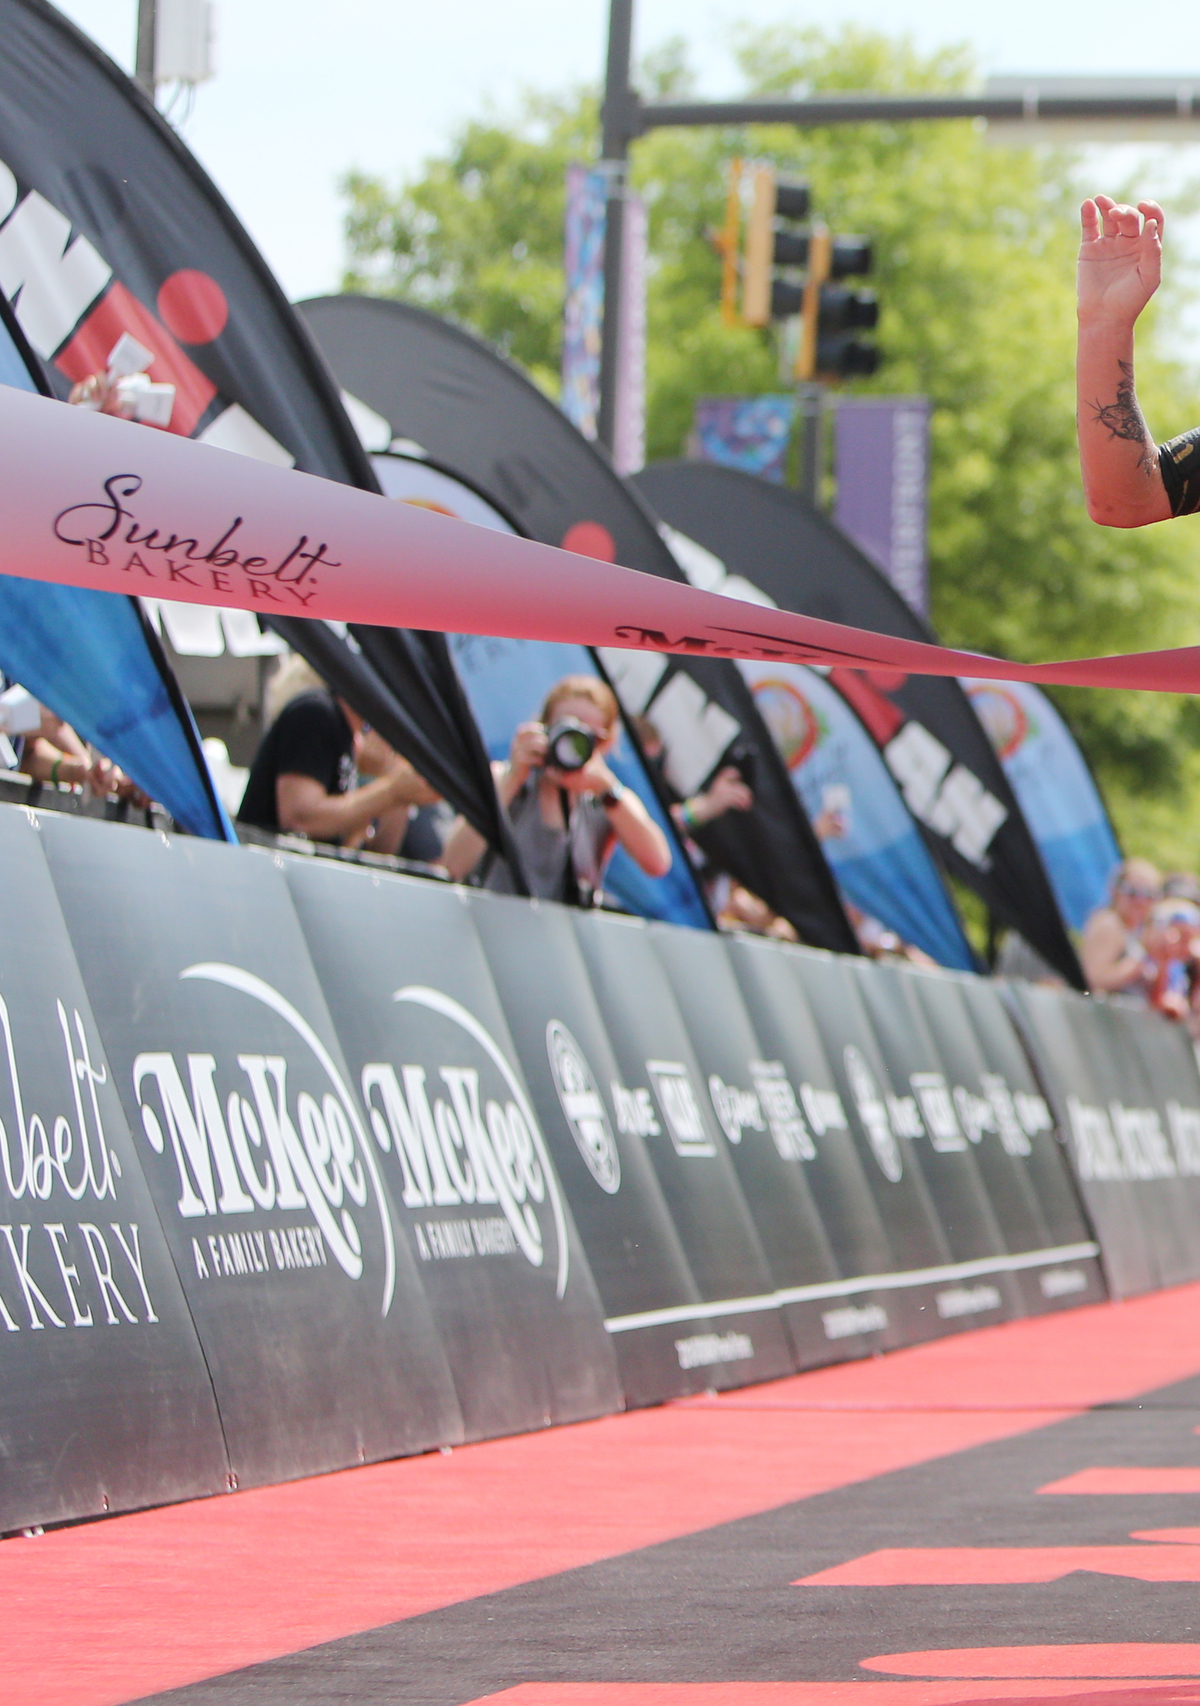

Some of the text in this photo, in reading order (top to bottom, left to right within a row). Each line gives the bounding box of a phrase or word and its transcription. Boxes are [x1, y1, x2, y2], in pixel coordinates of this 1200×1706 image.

[86, 538, 318, 607] BAKERY
[133, 1052, 366, 1279] McKee
[361, 1062, 545, 1267] McKee
[0, 1222, 160, 1332] KERY
[192, 1236, 210, 1279] A
[207, 1230, 271, 1277] FAMILY
